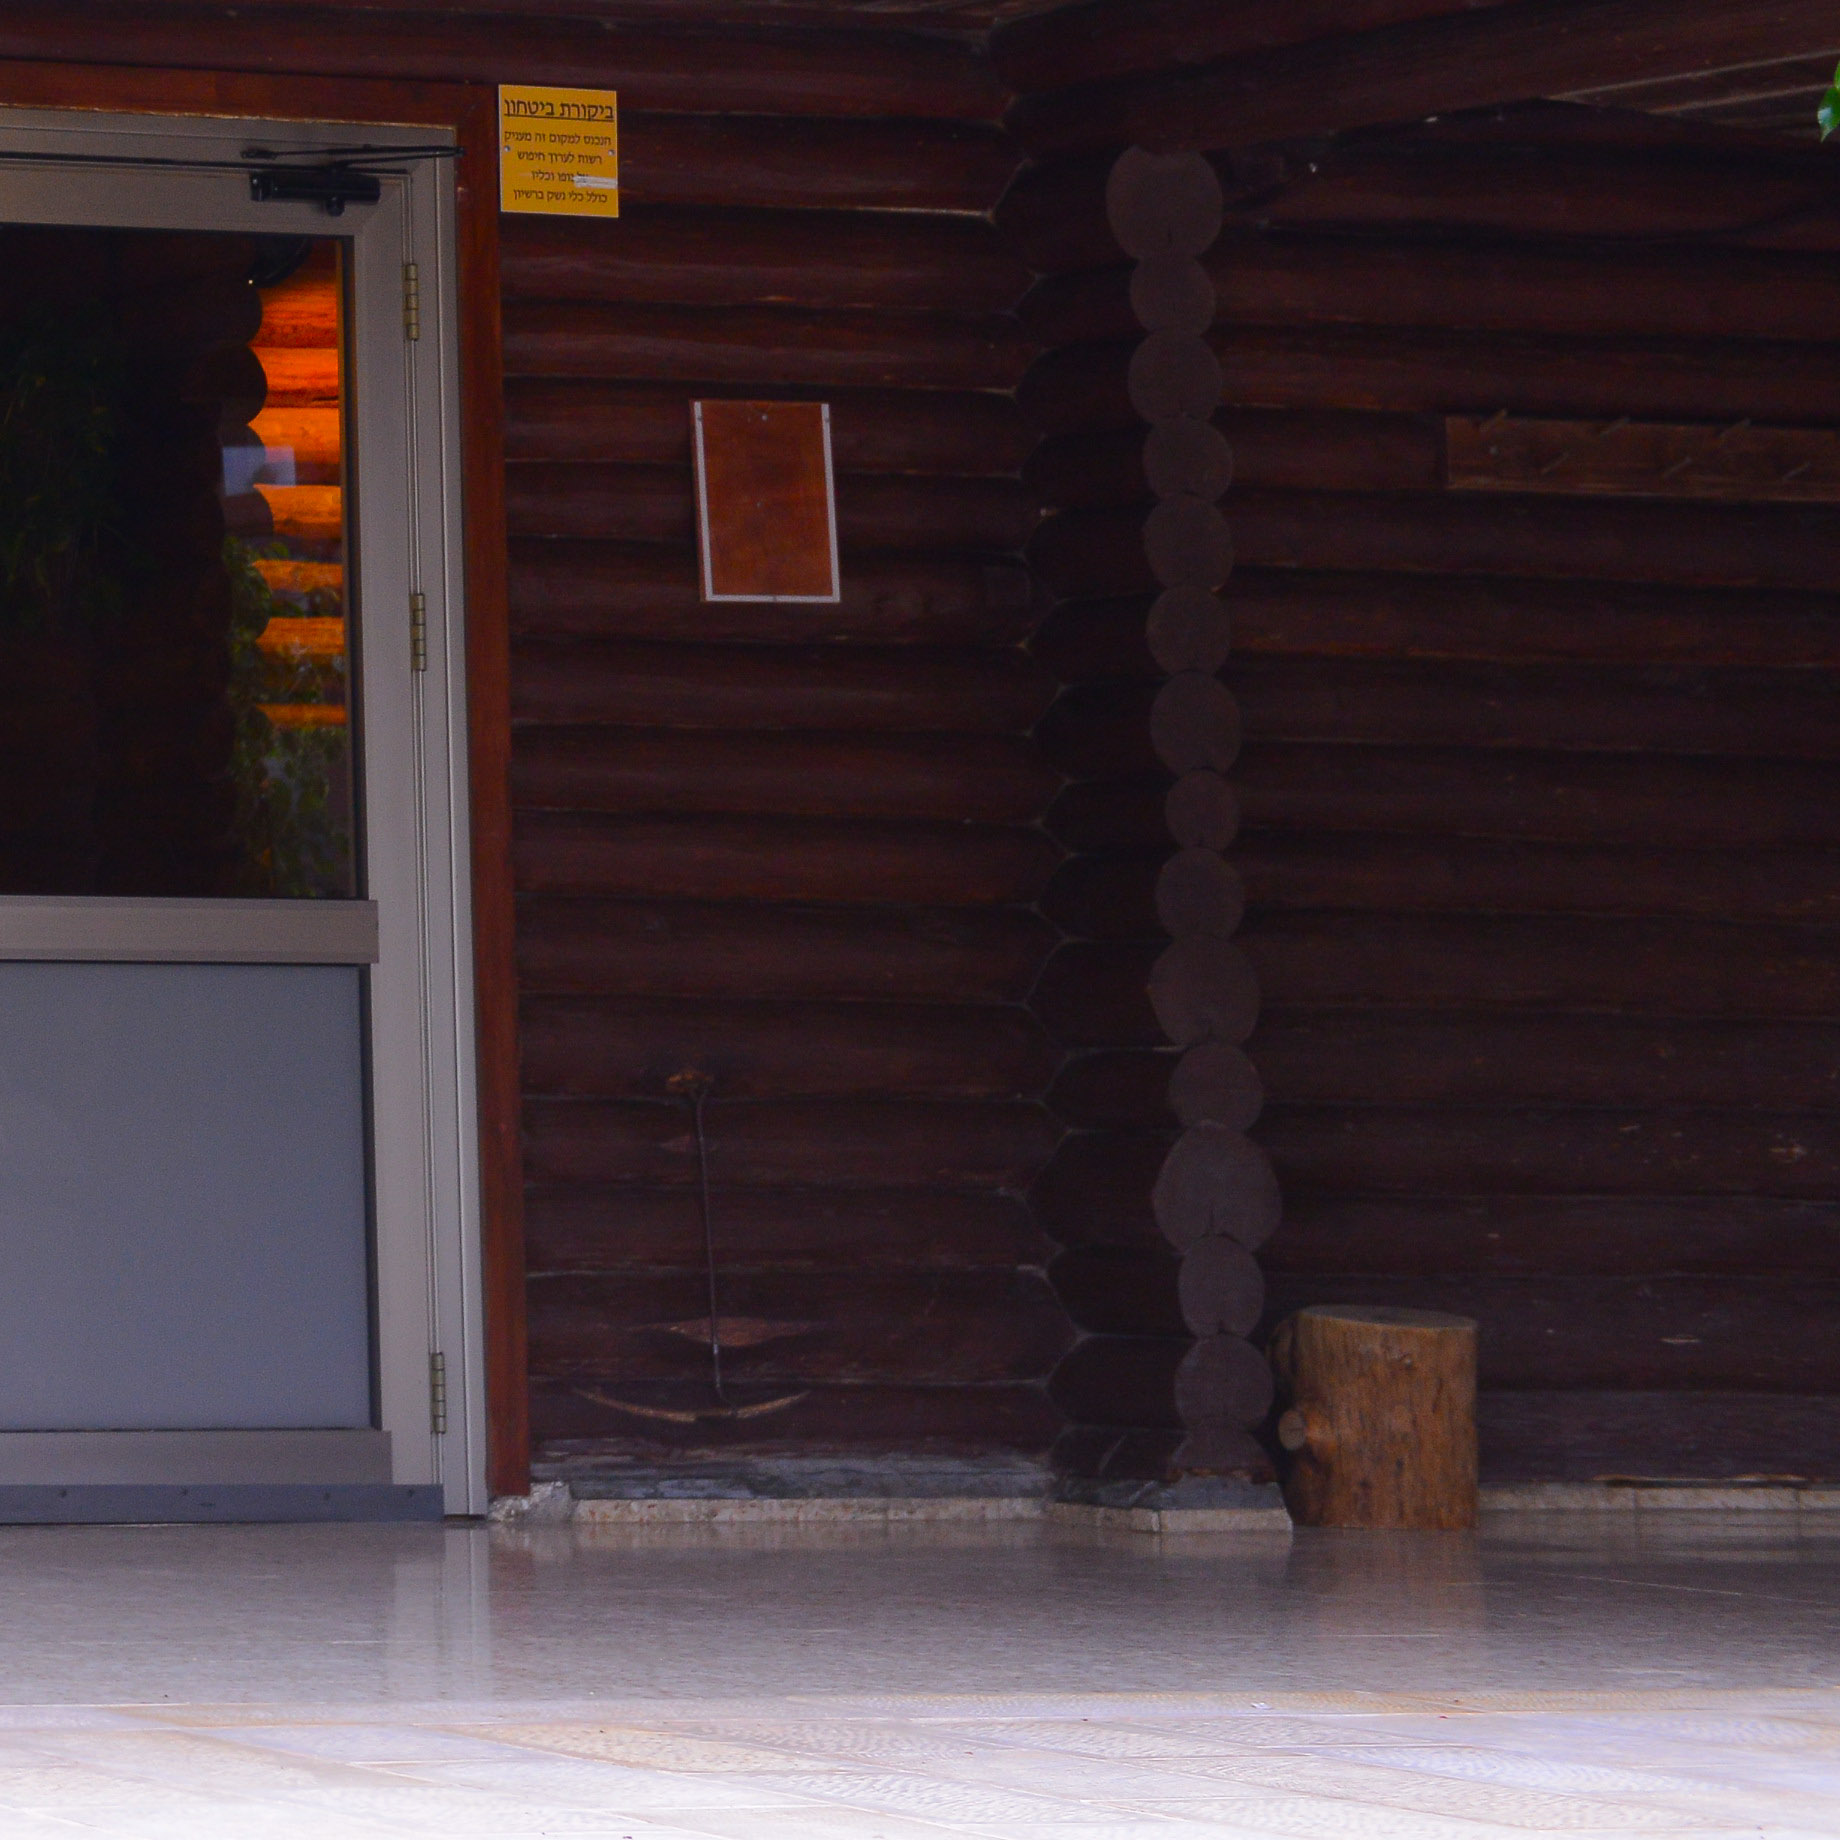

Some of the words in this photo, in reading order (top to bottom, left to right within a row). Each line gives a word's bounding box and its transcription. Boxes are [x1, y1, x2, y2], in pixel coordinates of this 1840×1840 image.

[504, 99, 555, 116] ביטחון
[560, 102, 614, 120] ביקורת
[504, 131, 532, 142] מעניק
[535, 132, 546, 142] זה
[549, 132, 581, 145] למקום
[584, 135, 611, 146] הנכנס
[517, 151, 545, 161] חיפוש
[548, 152, 575, 164] לערוך
[578, 154, 602, 164] רשות
[546, 190, 566, 202] נשק
[569, 190, 584, 201] כלי
[586, 192, 608, 203] כולל
